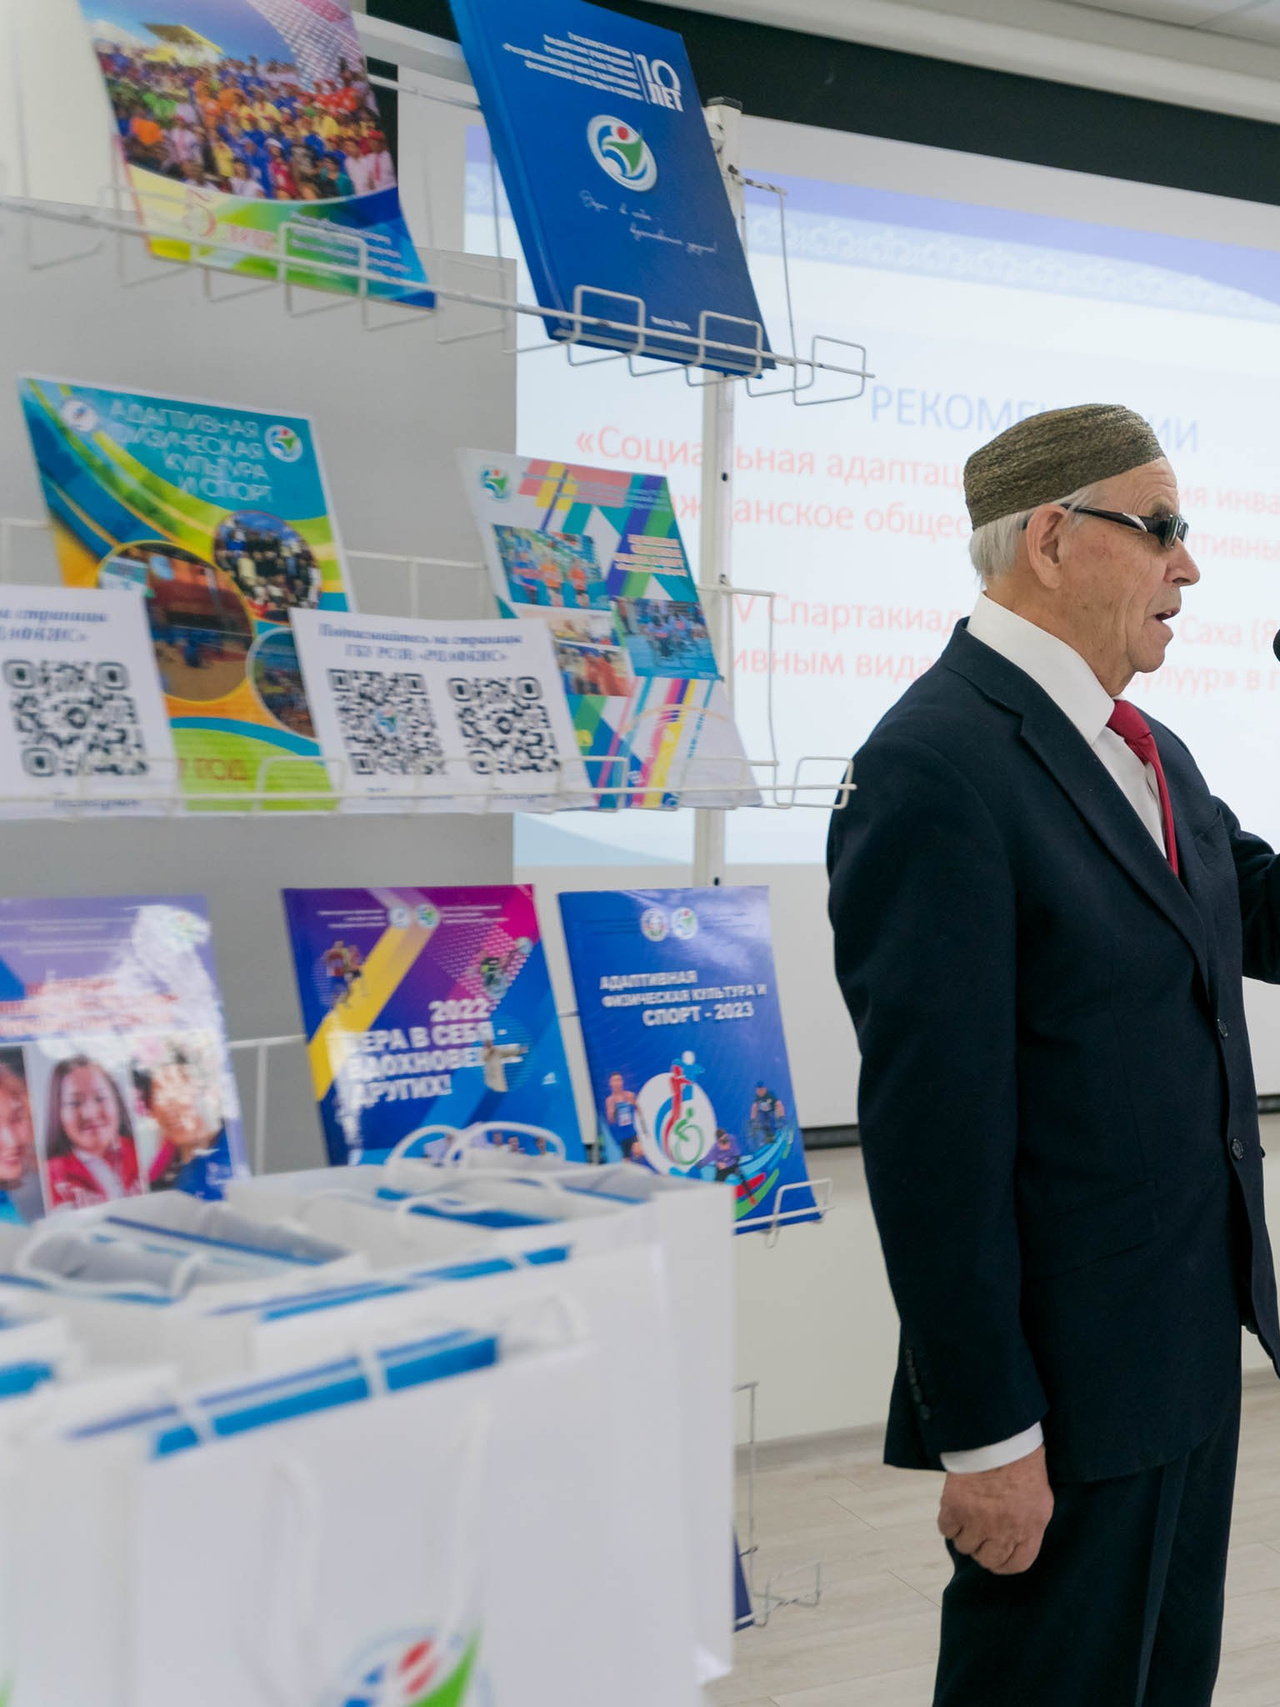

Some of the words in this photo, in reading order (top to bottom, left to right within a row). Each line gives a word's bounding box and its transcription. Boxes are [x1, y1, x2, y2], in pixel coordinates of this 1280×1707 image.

[636, 54, 682, 92] 10
[871, 384, 1200, 454] РЕКОМИИ
[576, 425, 815, 476] «Социаьная
[826, 452, 965, 494] адаптац
[864, 502, 972, 542] общес
[767, 592, 963, 638] Спартакиад
[1178, 617, 1243, 647] Саха
[856, 653, 936, 684] вида
[600, 970, 698, 991] АДАПТИВНАЯ
[692, 985, 756, 1001] КУЛЬТУРА
[642, 1005, 702, 1027] СПОРТ
[714, 1001, 754, 1020] 2023
[347, 1028, 409, 1054] ЕРА
[409, 1026, 431, 1048] В
